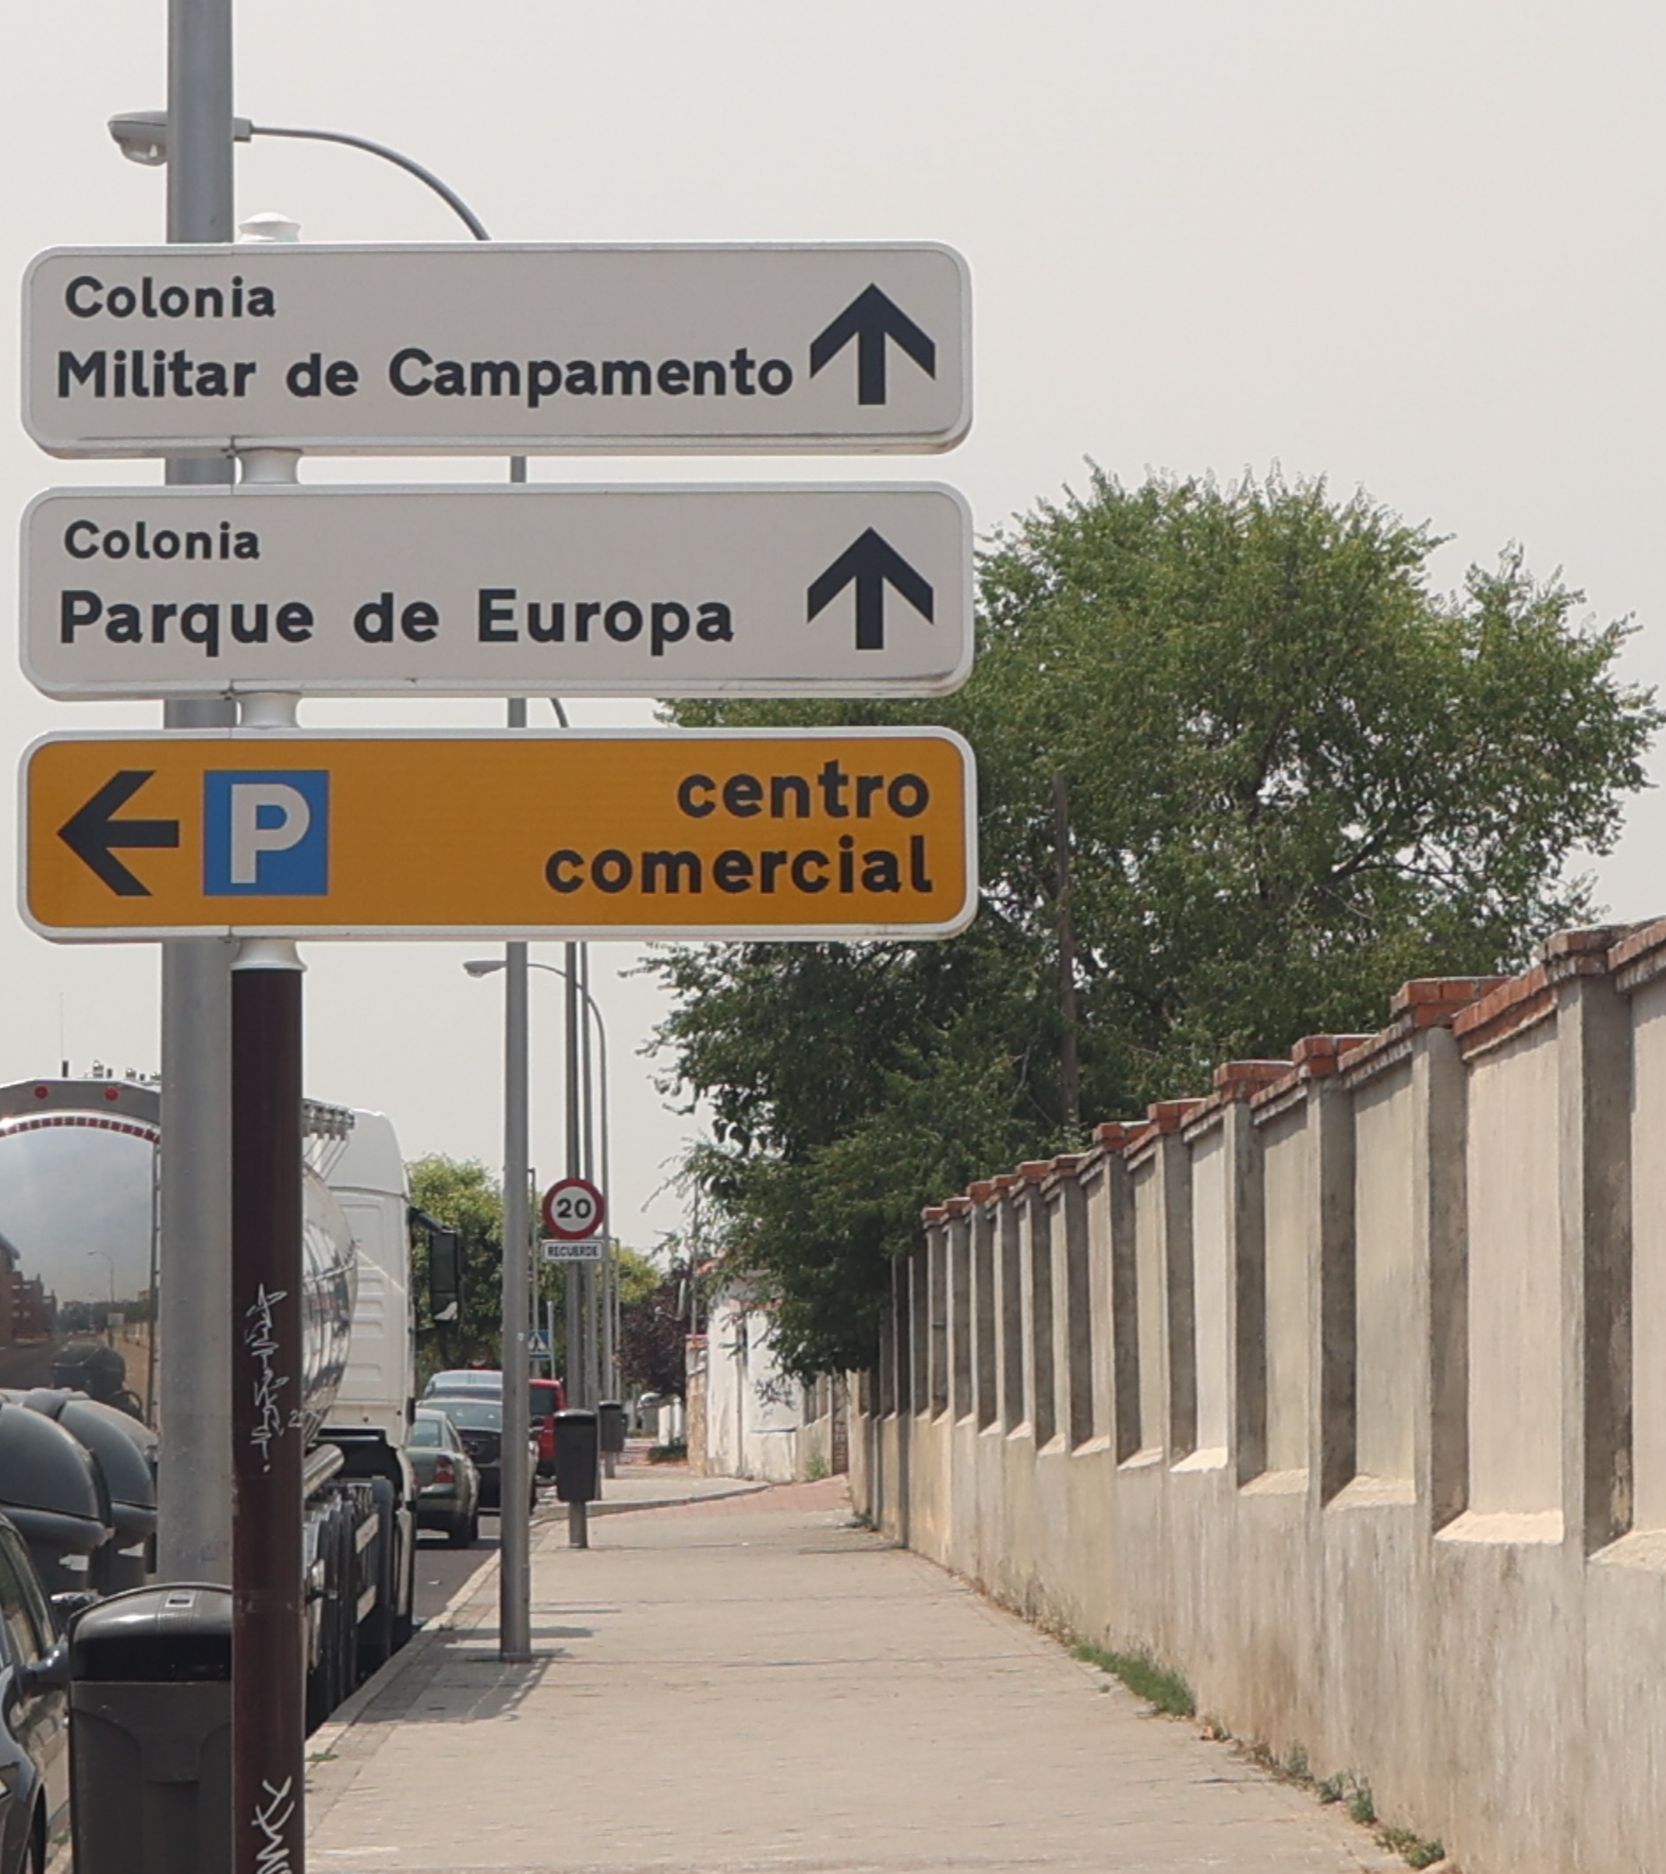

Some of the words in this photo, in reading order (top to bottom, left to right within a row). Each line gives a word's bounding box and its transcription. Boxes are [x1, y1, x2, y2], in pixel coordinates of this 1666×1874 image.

[65, 276, 276, 319] Colonia
[58, 350, 257, 398] Militar
[286, 352, 359, 398] de
[388, 347, 794, 409] Campamento
[64, 520, 260, 560] Colonia
[60, 590, 314, 658] Parque
[353, 591, 439, 644] de
[478, 588, 734, 657] Europa
[677, 759, 930, 819] centro
[229, 783, 311, 885] P
[545, 834, 933, 894] comercial
[557, 1198, 591, 1219] 20
[547, 1245, 598, 1258] RECUERDE
